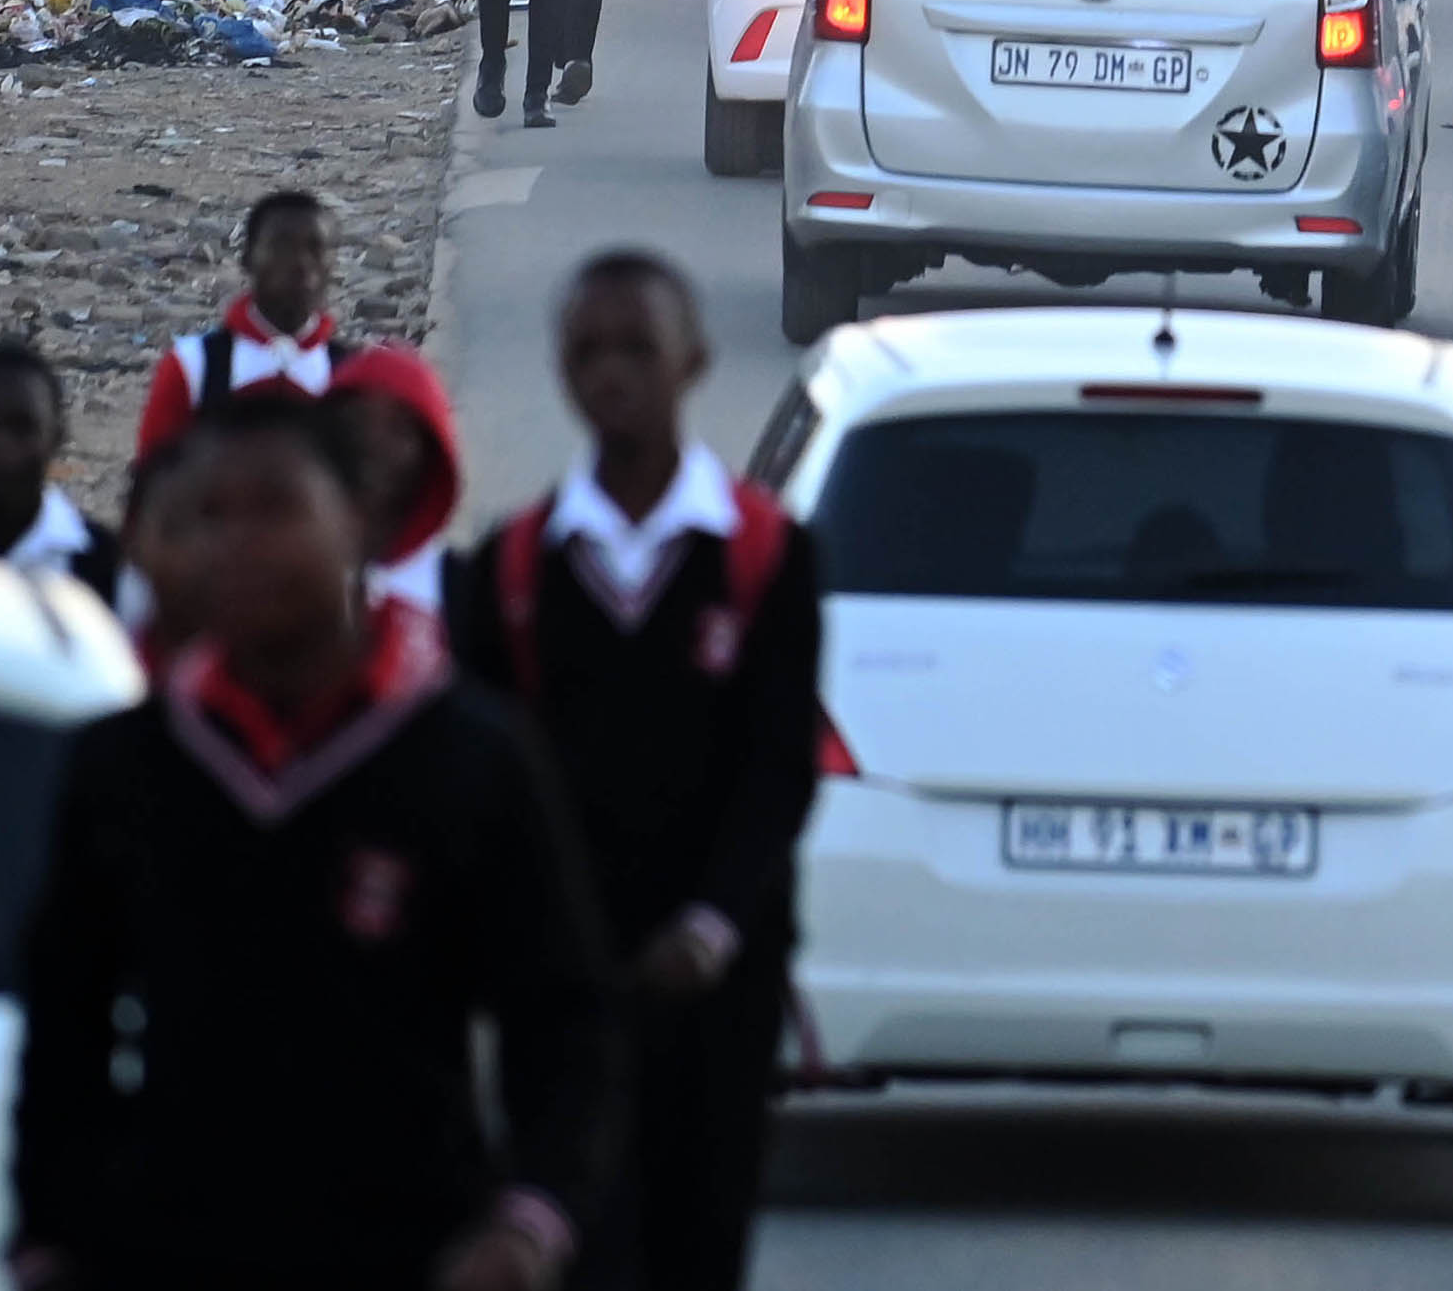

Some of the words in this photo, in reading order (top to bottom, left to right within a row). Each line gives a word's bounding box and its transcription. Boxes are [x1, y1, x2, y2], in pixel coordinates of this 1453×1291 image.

[999, 48, 1029, 76] JN
[1049, 50, 1079, 81] 79
[1094, 53, 1125, 83] DM
[1153, 56, 1184, 85] GP
